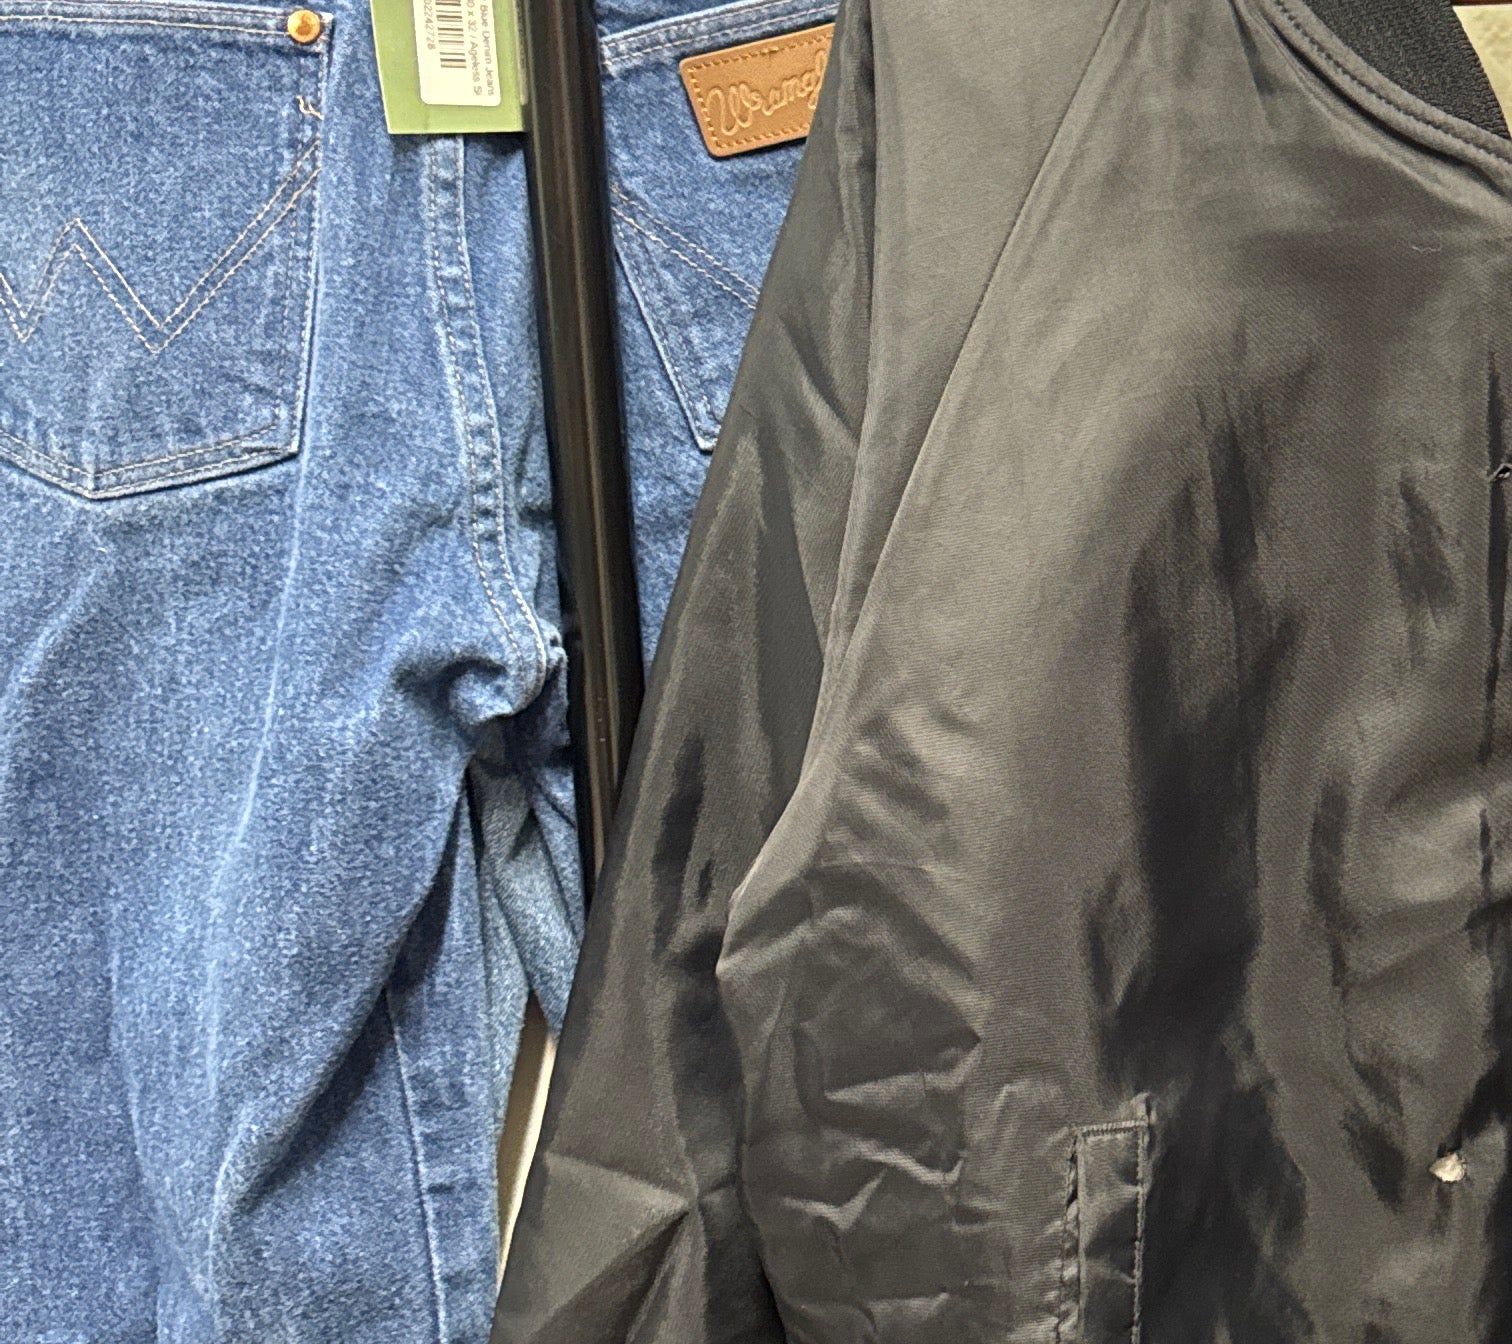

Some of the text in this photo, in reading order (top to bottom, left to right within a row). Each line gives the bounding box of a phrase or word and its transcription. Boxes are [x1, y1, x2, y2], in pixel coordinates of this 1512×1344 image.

[480, 5, 490, 27] Blue
[482, 30, 492, 64] Denim
[485, 66, 495, 96] Jeans
[705, 49, 827, 136] Wrangl
